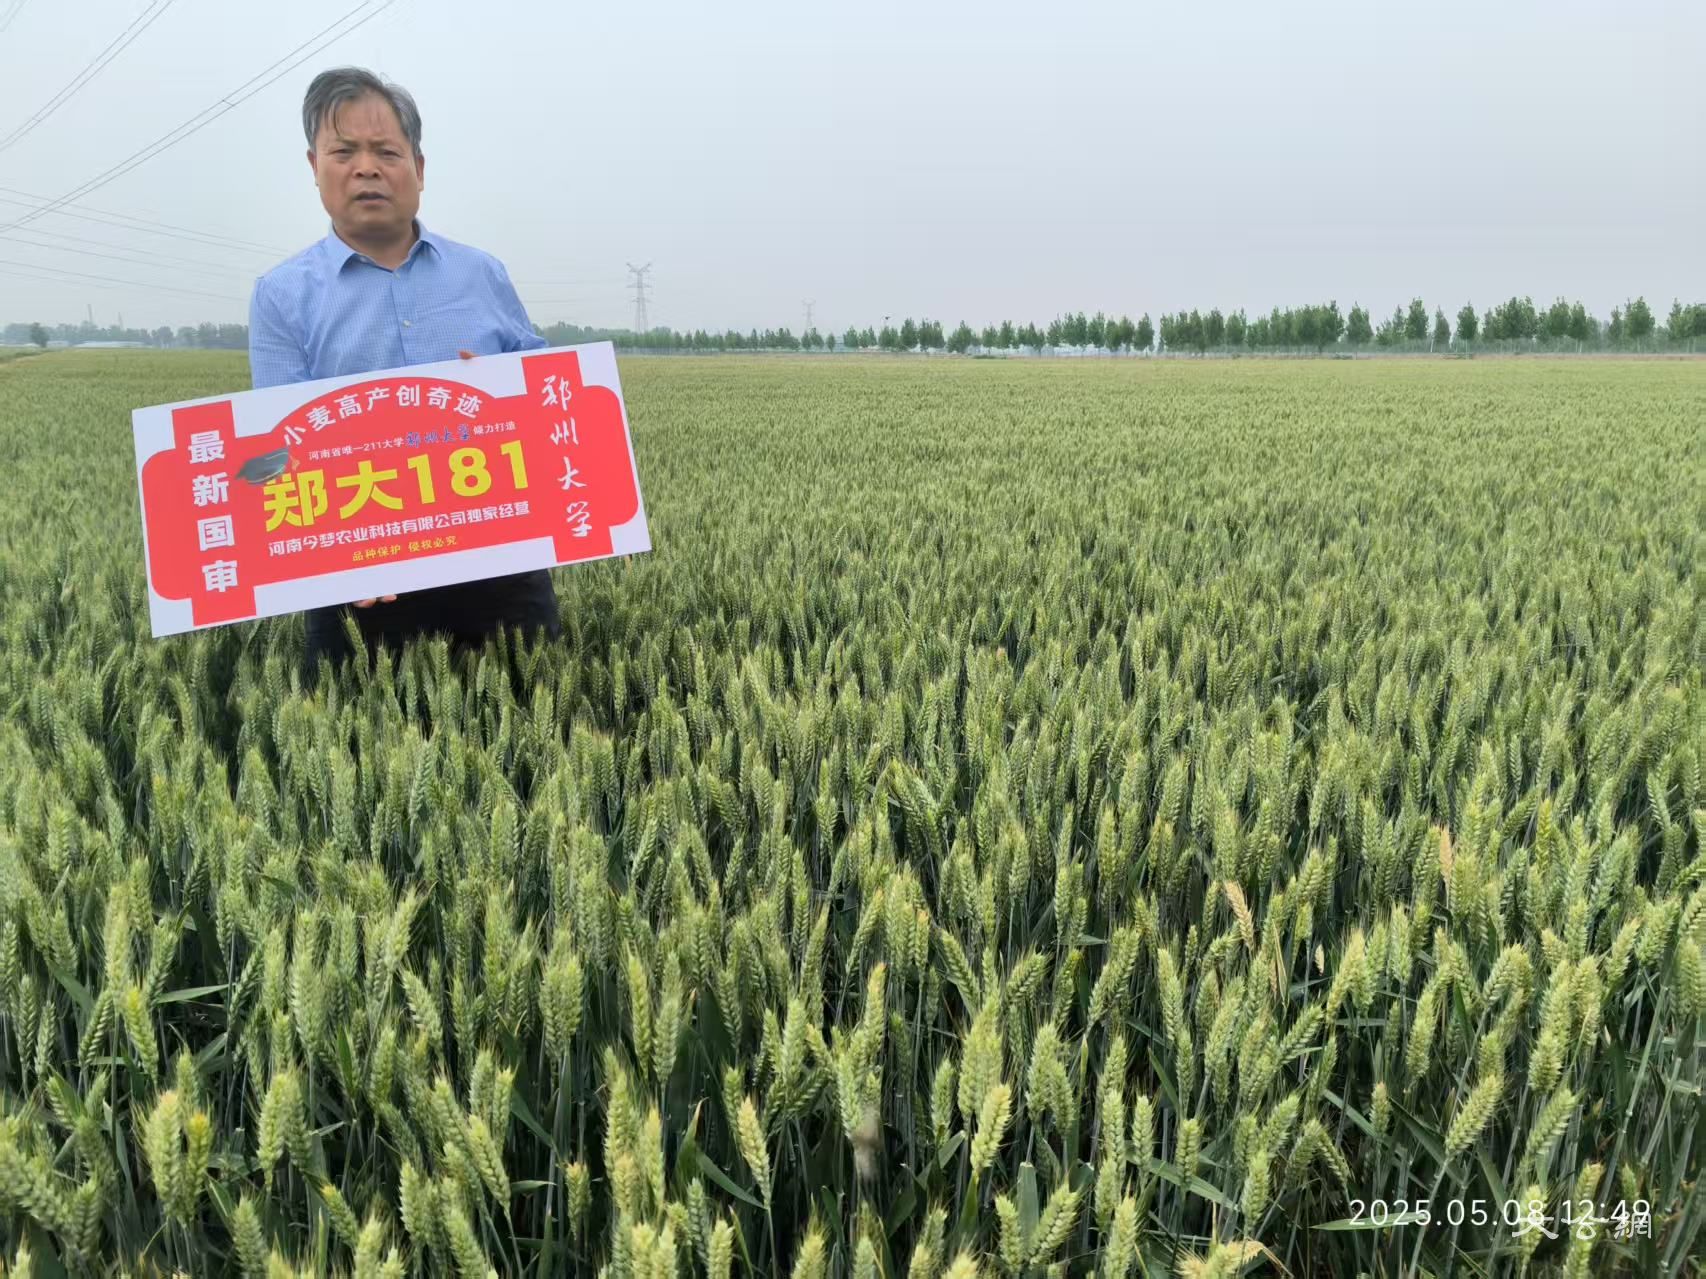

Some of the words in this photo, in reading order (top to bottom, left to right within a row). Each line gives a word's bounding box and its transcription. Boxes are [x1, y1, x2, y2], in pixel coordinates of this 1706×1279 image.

[282, 384, 483, 447] 小麦高产创奇迹
[263, 440, 529, 532] 郑大181
[541, 375, 592, 537] 郑州大学
[188, 430, 239, 592] 最新国审
[268, 500, 530, 557] 河南今梦农业科技有限公司独家经营
[352, 544, 401, 562] 品种保护
[408, 535, 458, 553] 侵权必究
